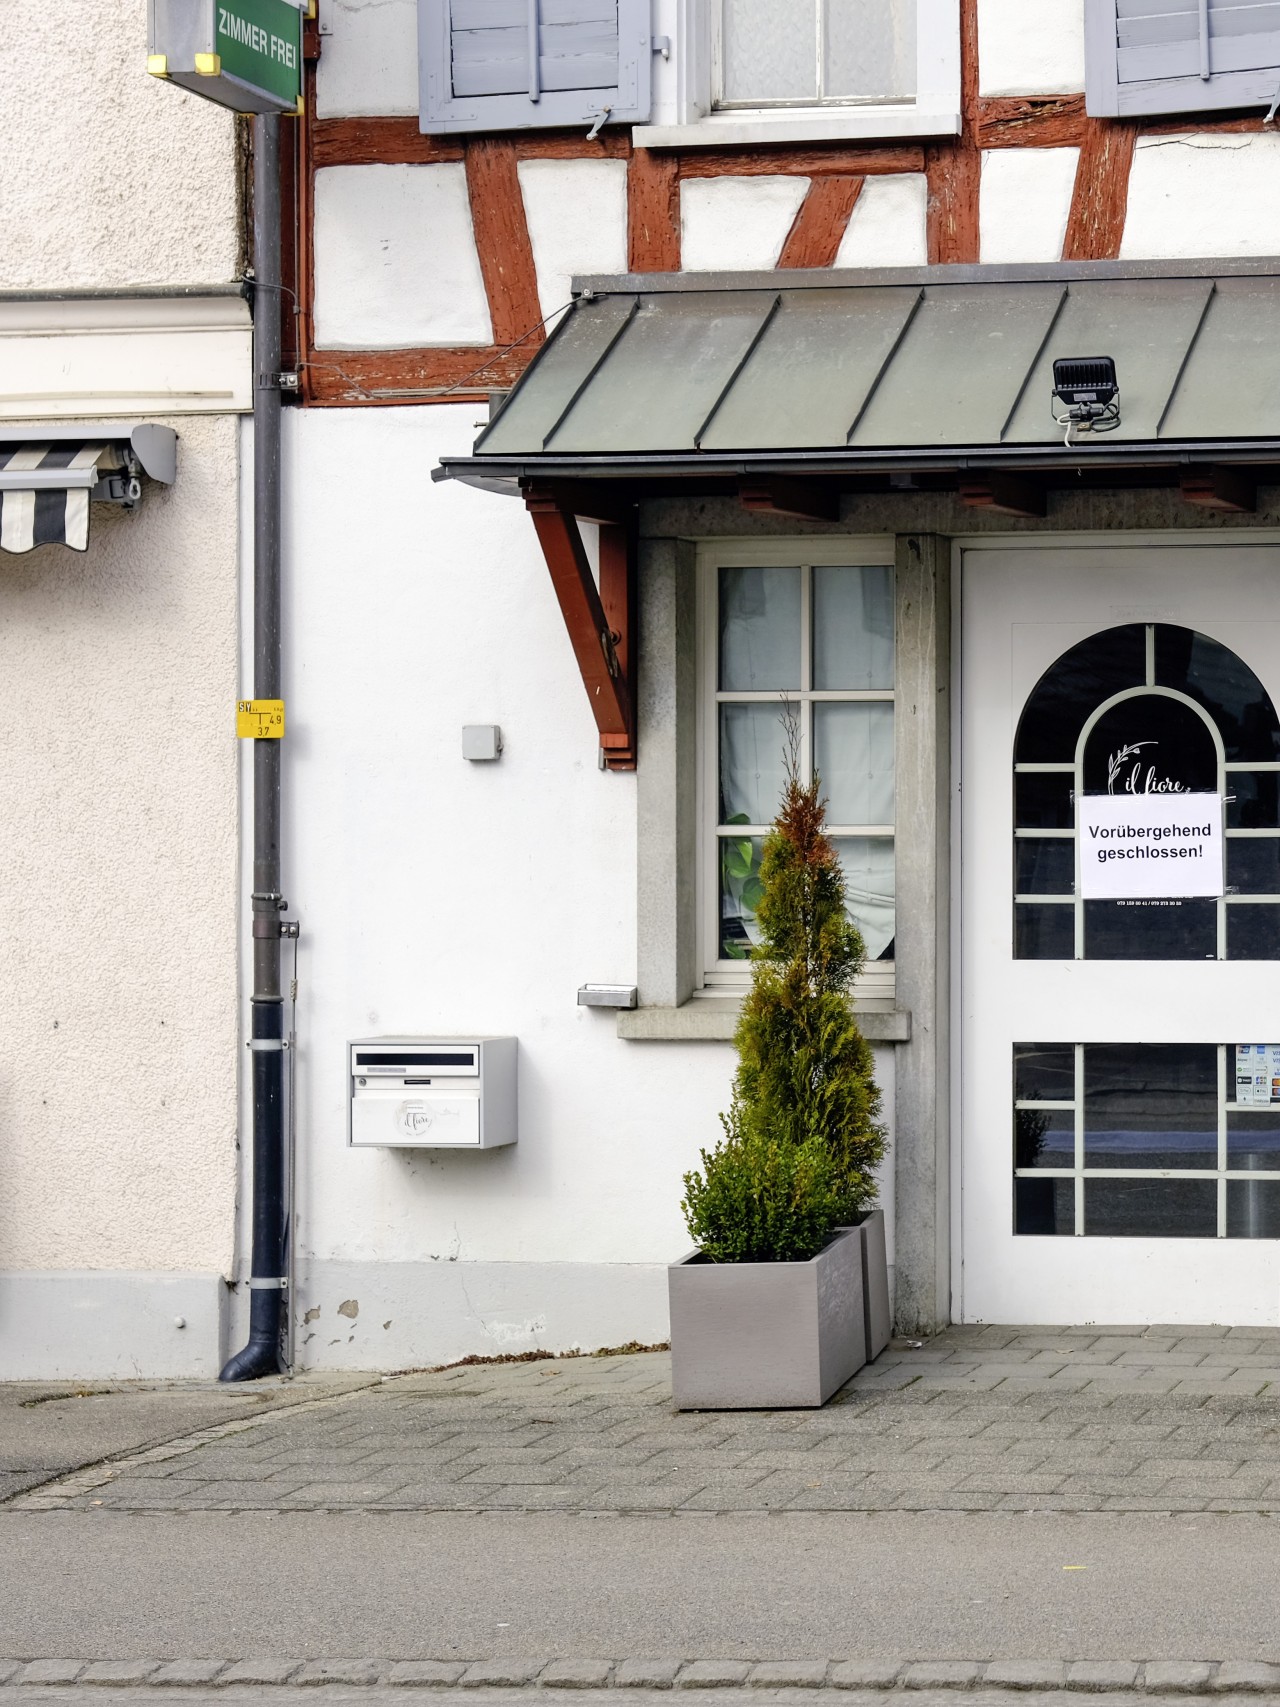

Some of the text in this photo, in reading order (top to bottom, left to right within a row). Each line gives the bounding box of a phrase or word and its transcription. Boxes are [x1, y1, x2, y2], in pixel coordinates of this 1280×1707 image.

[218, 7, 296, 70] ZIMMER FREI
[1125, 762, 1141, 795] il
[1089, 823, 1212, 841] Vorübergehend
[1097, 844, 1203, 863] geschlossen!
